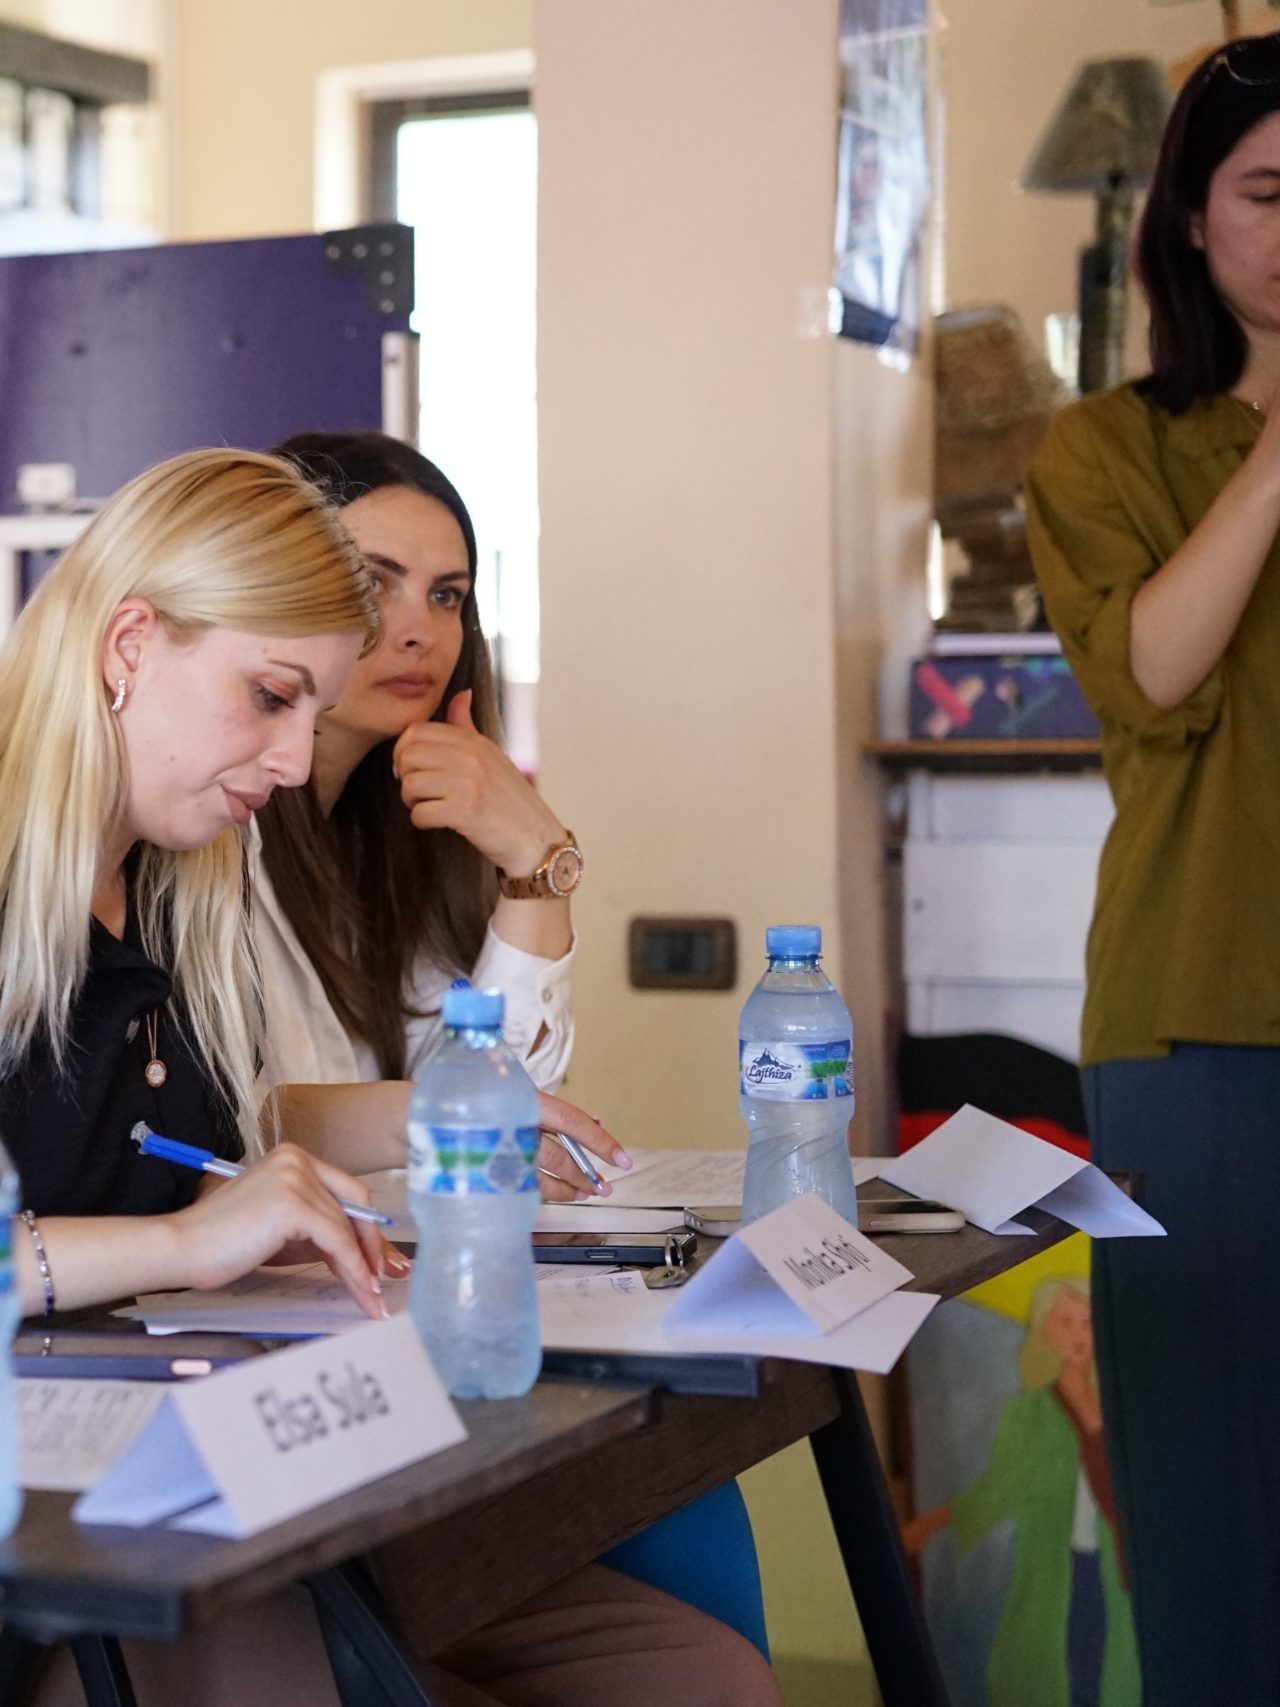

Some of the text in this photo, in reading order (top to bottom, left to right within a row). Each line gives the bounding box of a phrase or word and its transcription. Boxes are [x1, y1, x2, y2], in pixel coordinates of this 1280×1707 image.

[749, 1065, 792, 1083] Lajthiza
[255, 1362, 390, 1453] Elsa Sula
